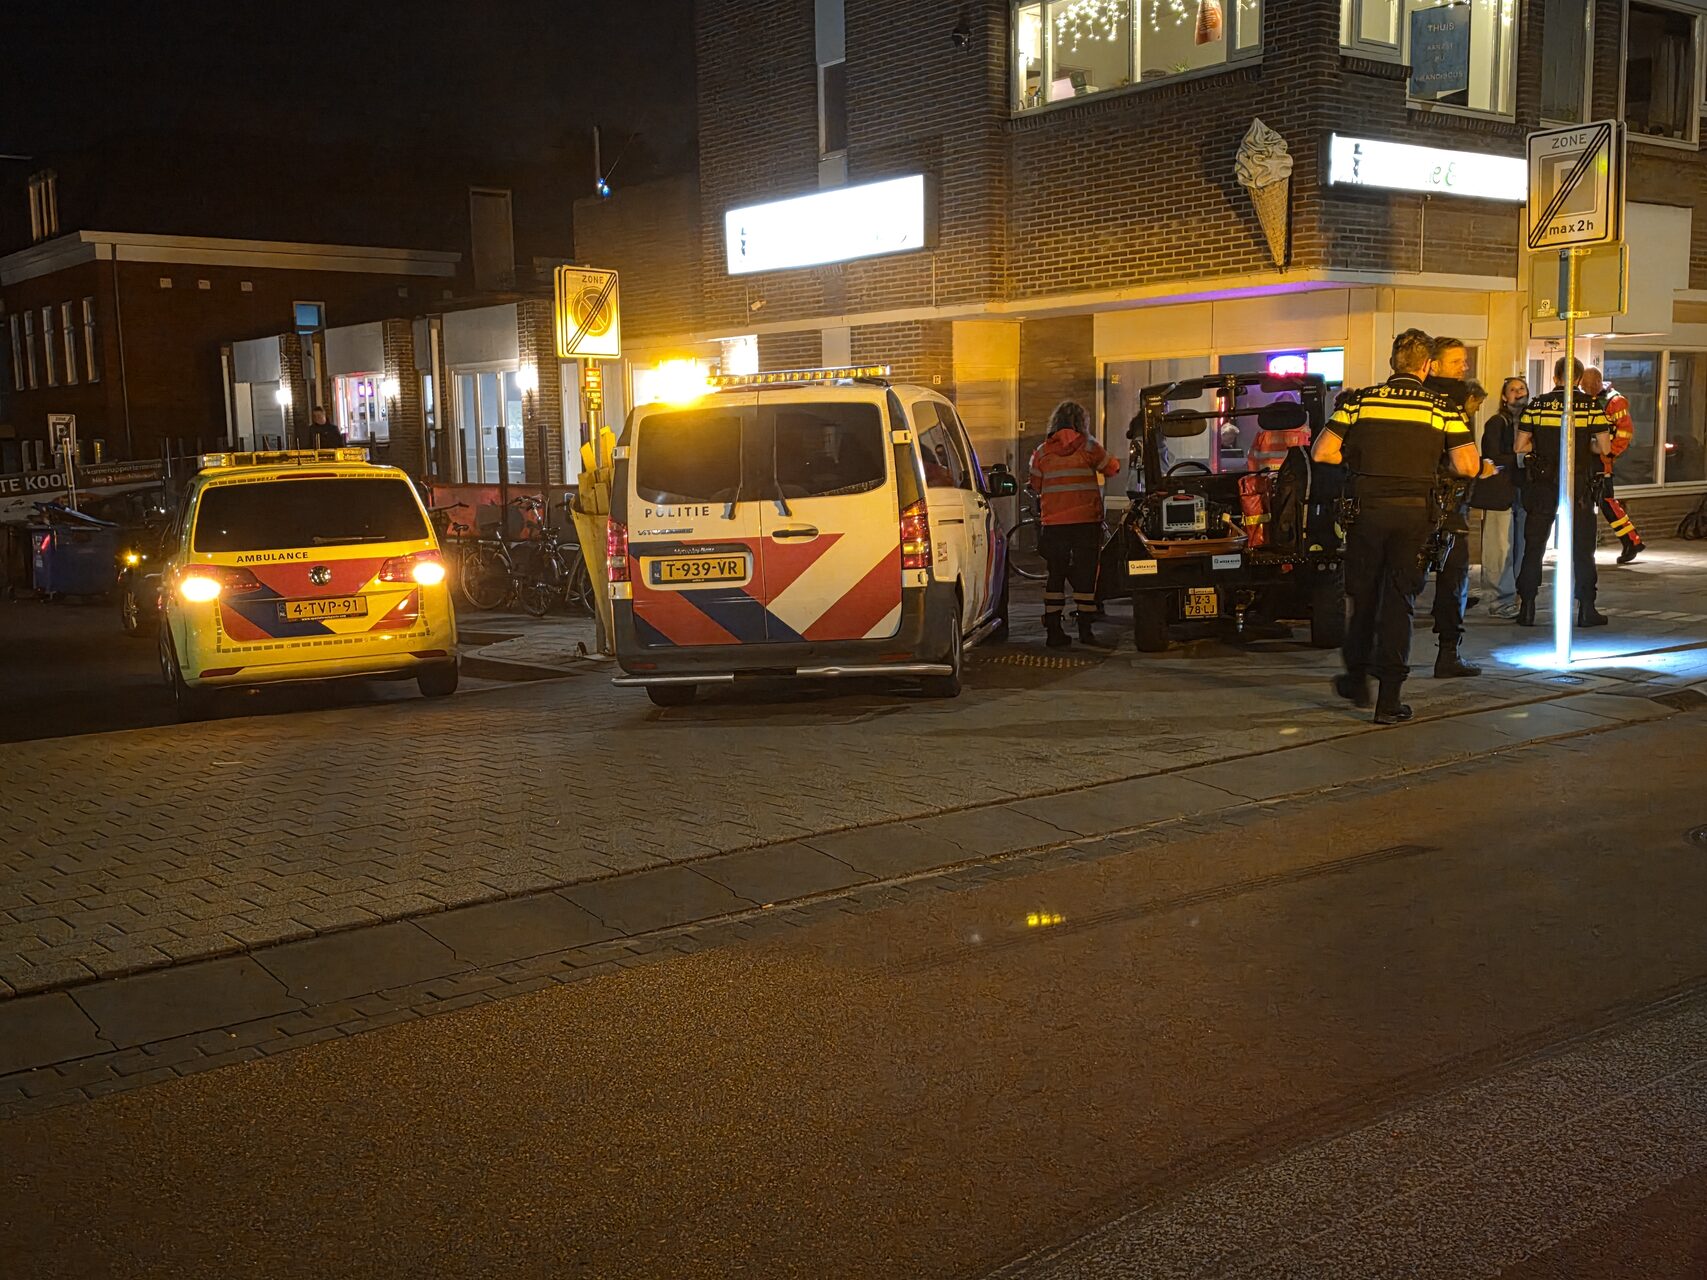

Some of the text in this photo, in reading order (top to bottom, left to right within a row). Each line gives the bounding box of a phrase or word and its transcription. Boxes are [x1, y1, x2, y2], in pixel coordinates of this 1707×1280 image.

[1427, 22, 1455, 33] THUIS
[1551, 133, 1587, 149] ZONE
[581, 274, 604, 284] ZONE
[1371, 385, 1426, 398] POLITIE
[0, 478, 21, 493] TE
[645, 505, 710, 518] POLITIE
[236, 551, 309, 563] AMBULANCE
[666, 560, 738, 578] T-939-VR
[293, 599, 359, 616] 4-TVP-91
